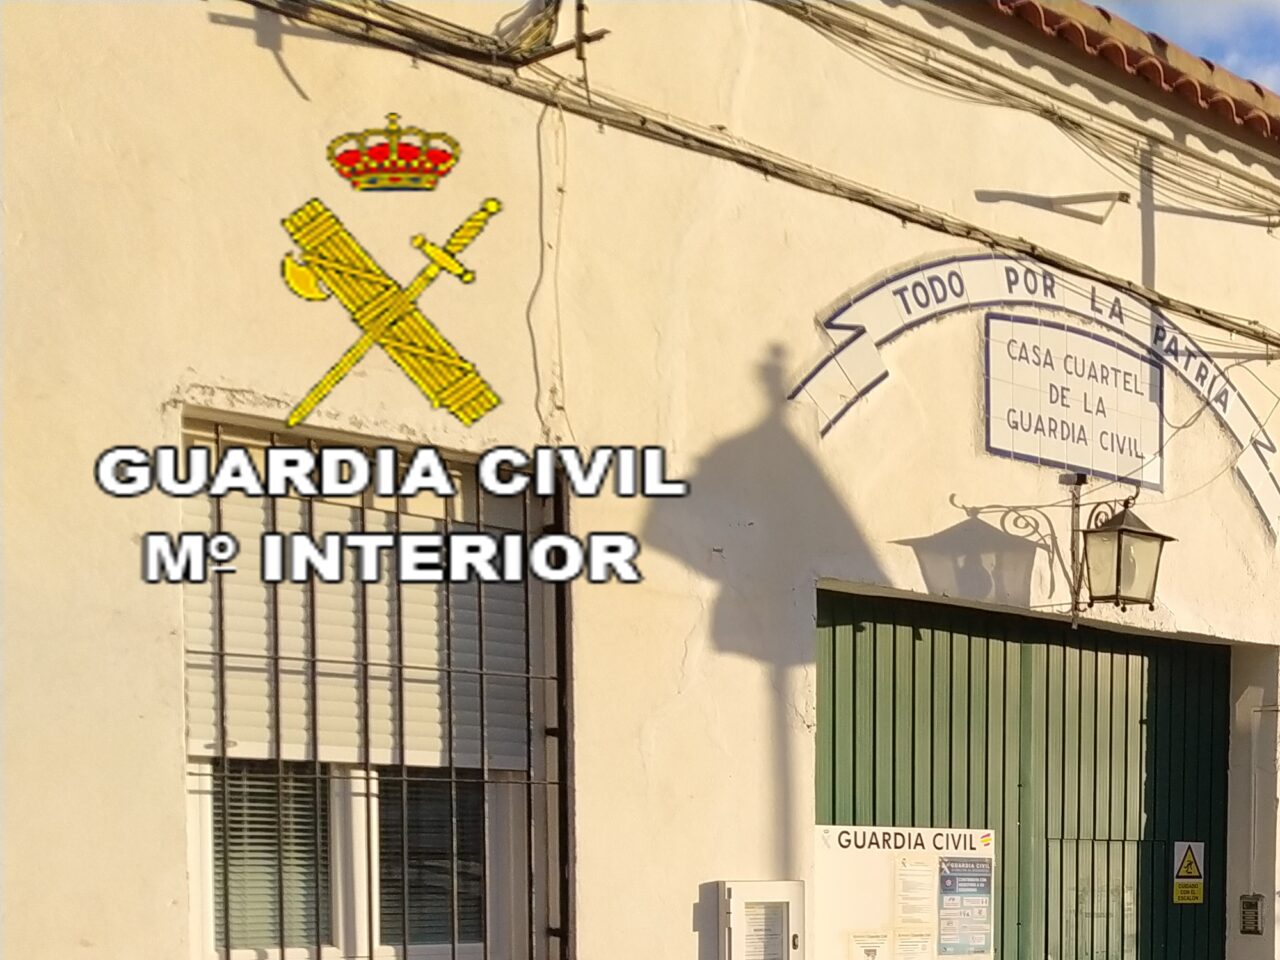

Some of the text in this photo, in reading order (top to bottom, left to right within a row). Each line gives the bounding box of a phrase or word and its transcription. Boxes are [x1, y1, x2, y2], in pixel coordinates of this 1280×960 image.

[892, 266, 1229, 414] TODO POR LA PATRIA
[1007, 339, 1144, 396] CASA CUARTEL
[1049, 383, 1107, 418] DE LA
[1007, 408, 1145, 459] GUARDIA CIVIL
[837, 830, 977, 850] GUARDIA CIVIL
